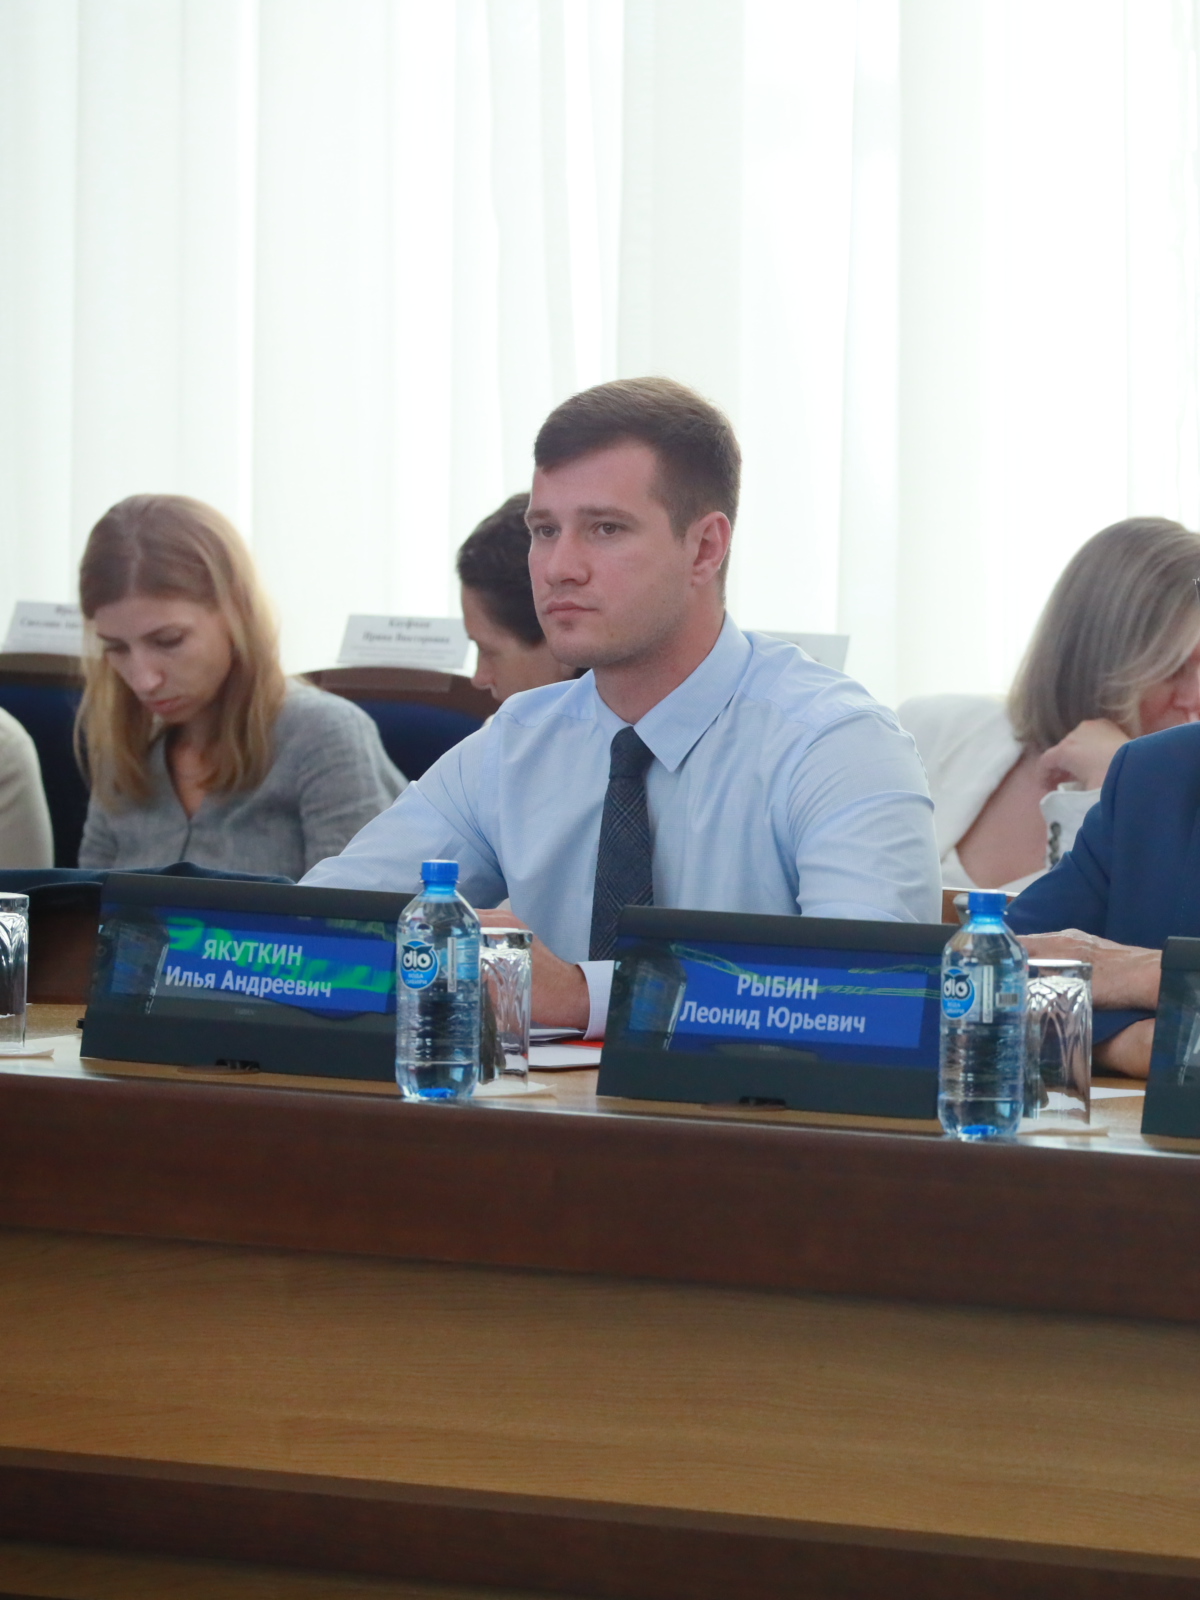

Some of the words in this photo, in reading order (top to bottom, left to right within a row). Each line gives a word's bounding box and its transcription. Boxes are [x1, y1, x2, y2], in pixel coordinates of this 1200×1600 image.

[202, 938, 303, 966] ЯКУТКИН
[403, 950, 431, 968] dio
[165, 966, 216, 989] Илья
[220, 970, 332, 998] Андреевич
[737, 974, 818, 1000] РЫБИН
[943, 978, 968, 997] dio
[680, 1001, 760, 1030] Леонид
[766, 1006, 866, 1034] Юрьевич
